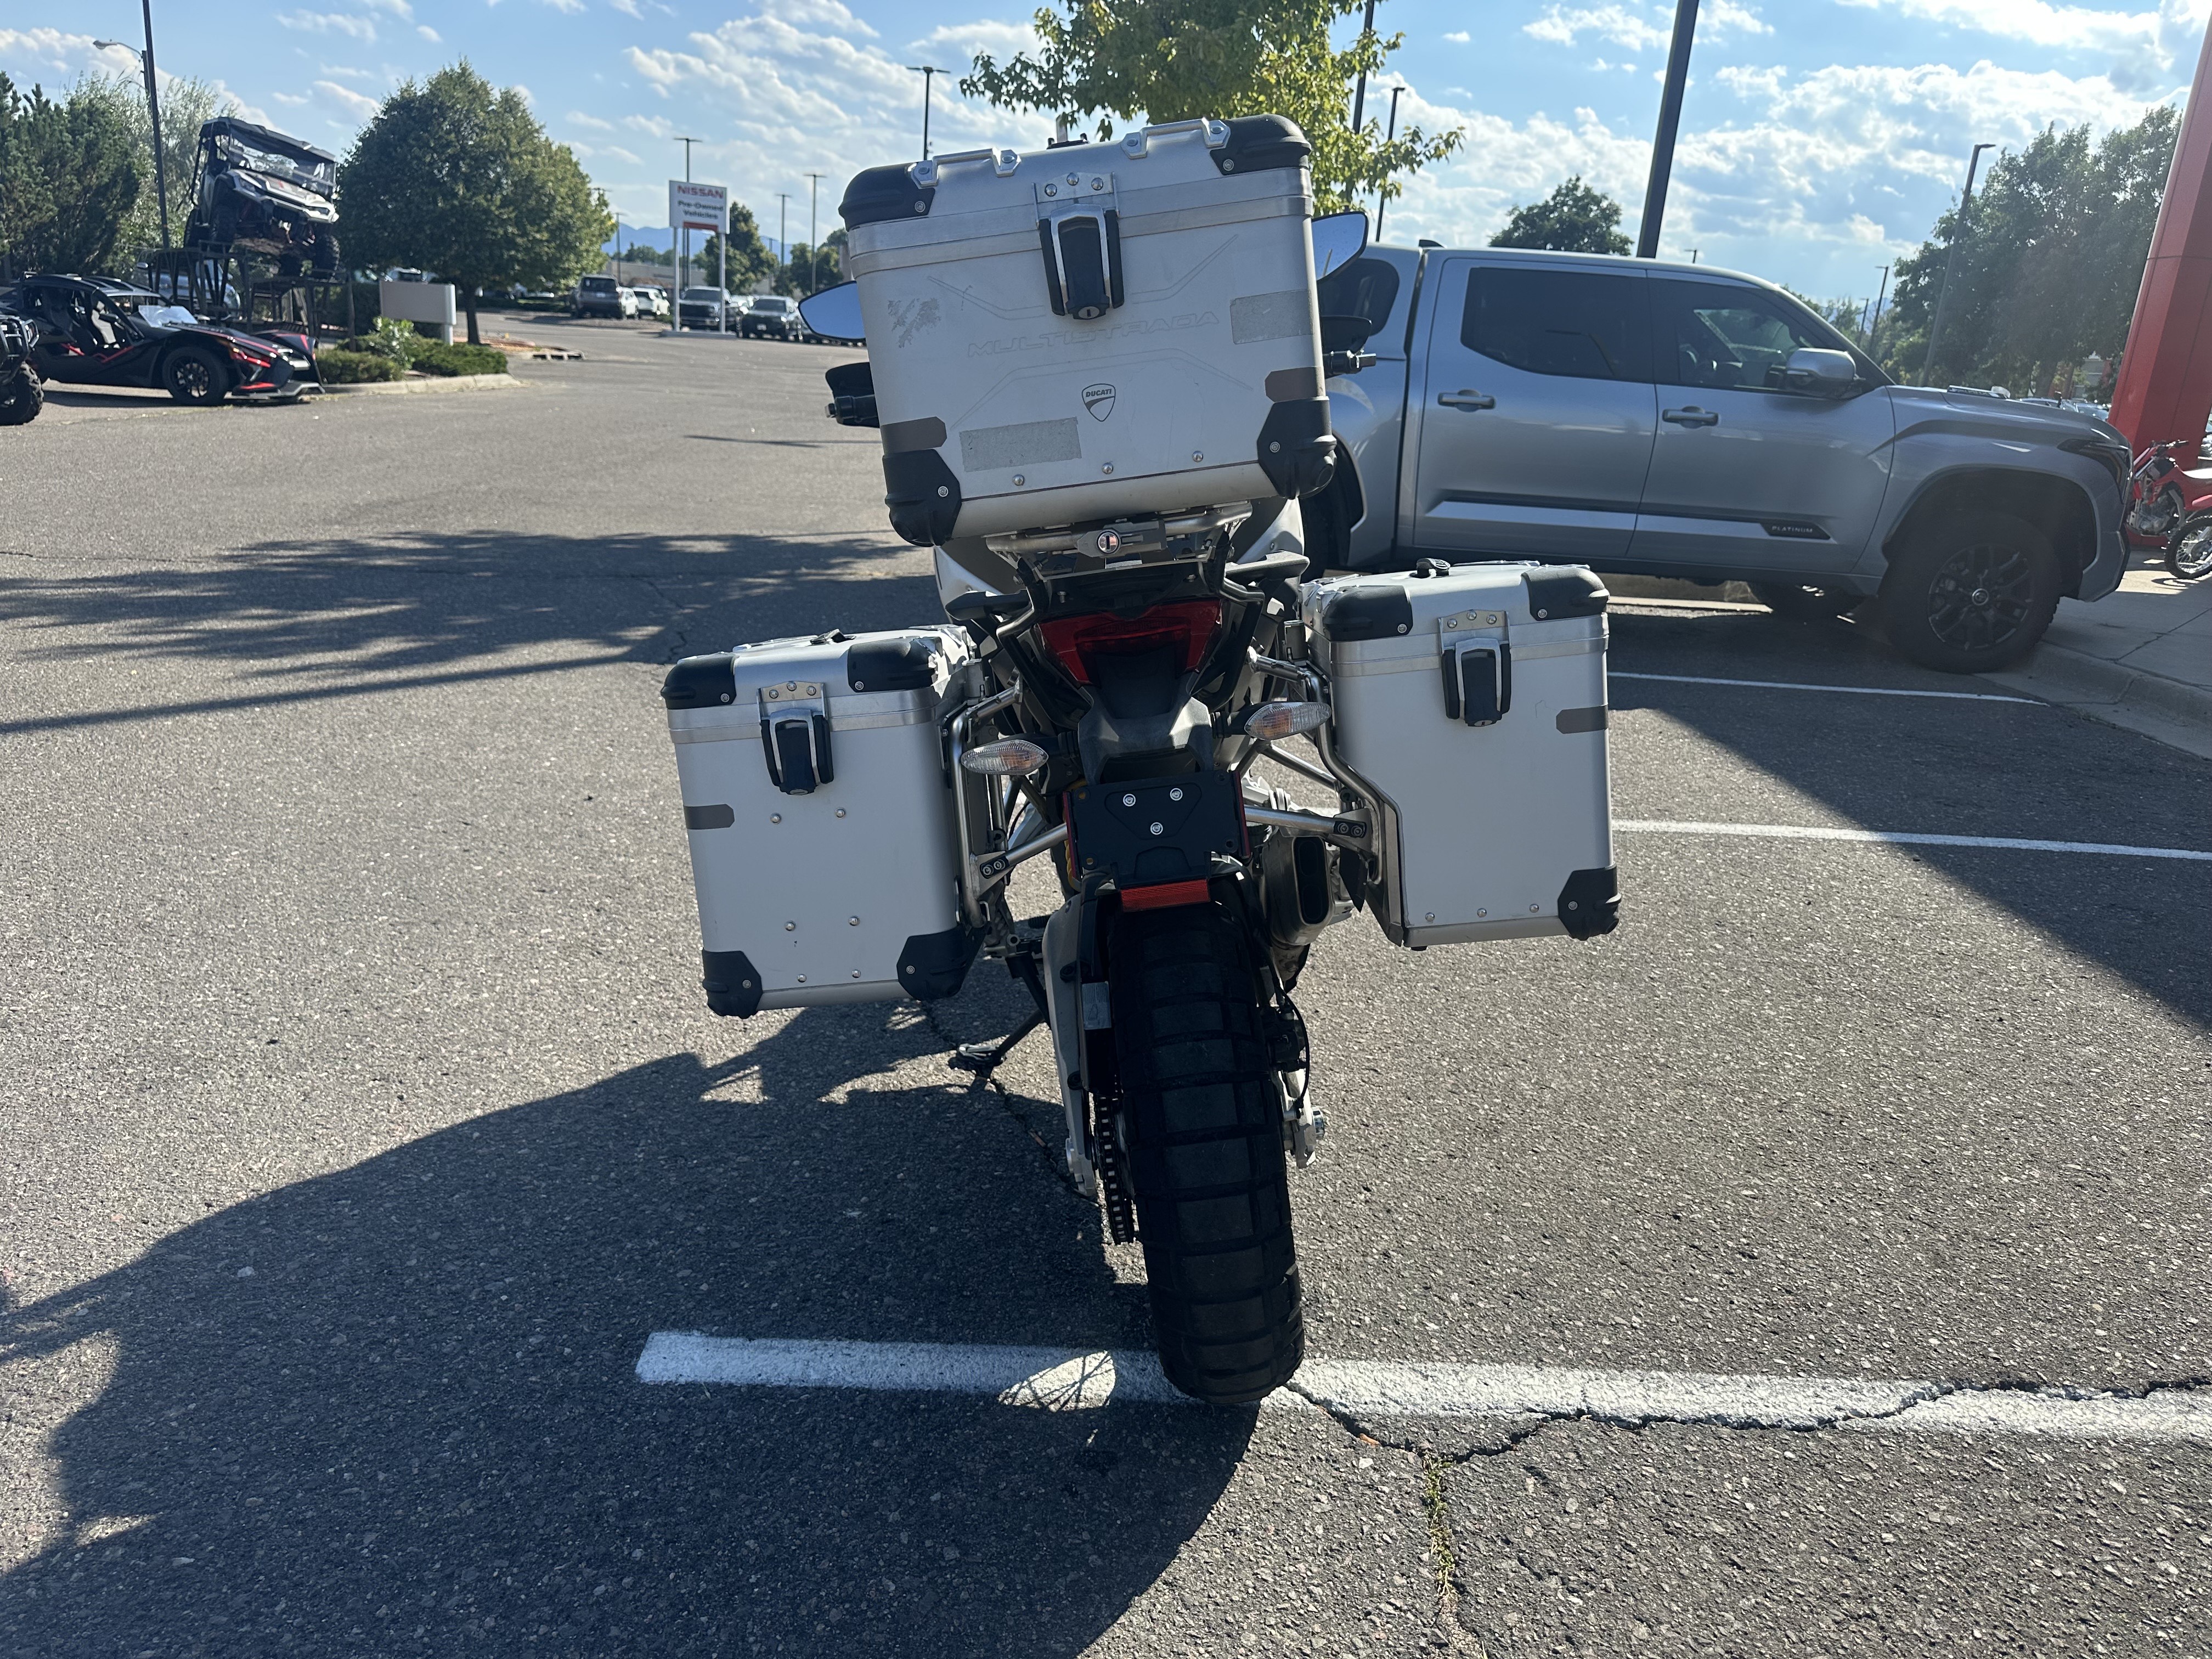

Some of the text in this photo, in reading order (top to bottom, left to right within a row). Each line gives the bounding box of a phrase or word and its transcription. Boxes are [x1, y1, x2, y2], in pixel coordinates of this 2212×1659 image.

[677, 185, 724, 199] NISSAN
[678, 200, 724, 211] Pre-Owned
[683, 210, 719, 219] Vehicles
[967, 311, 1220, 357] MULTISTRADA
[1086, 388, 1112, 397] DUCATI
